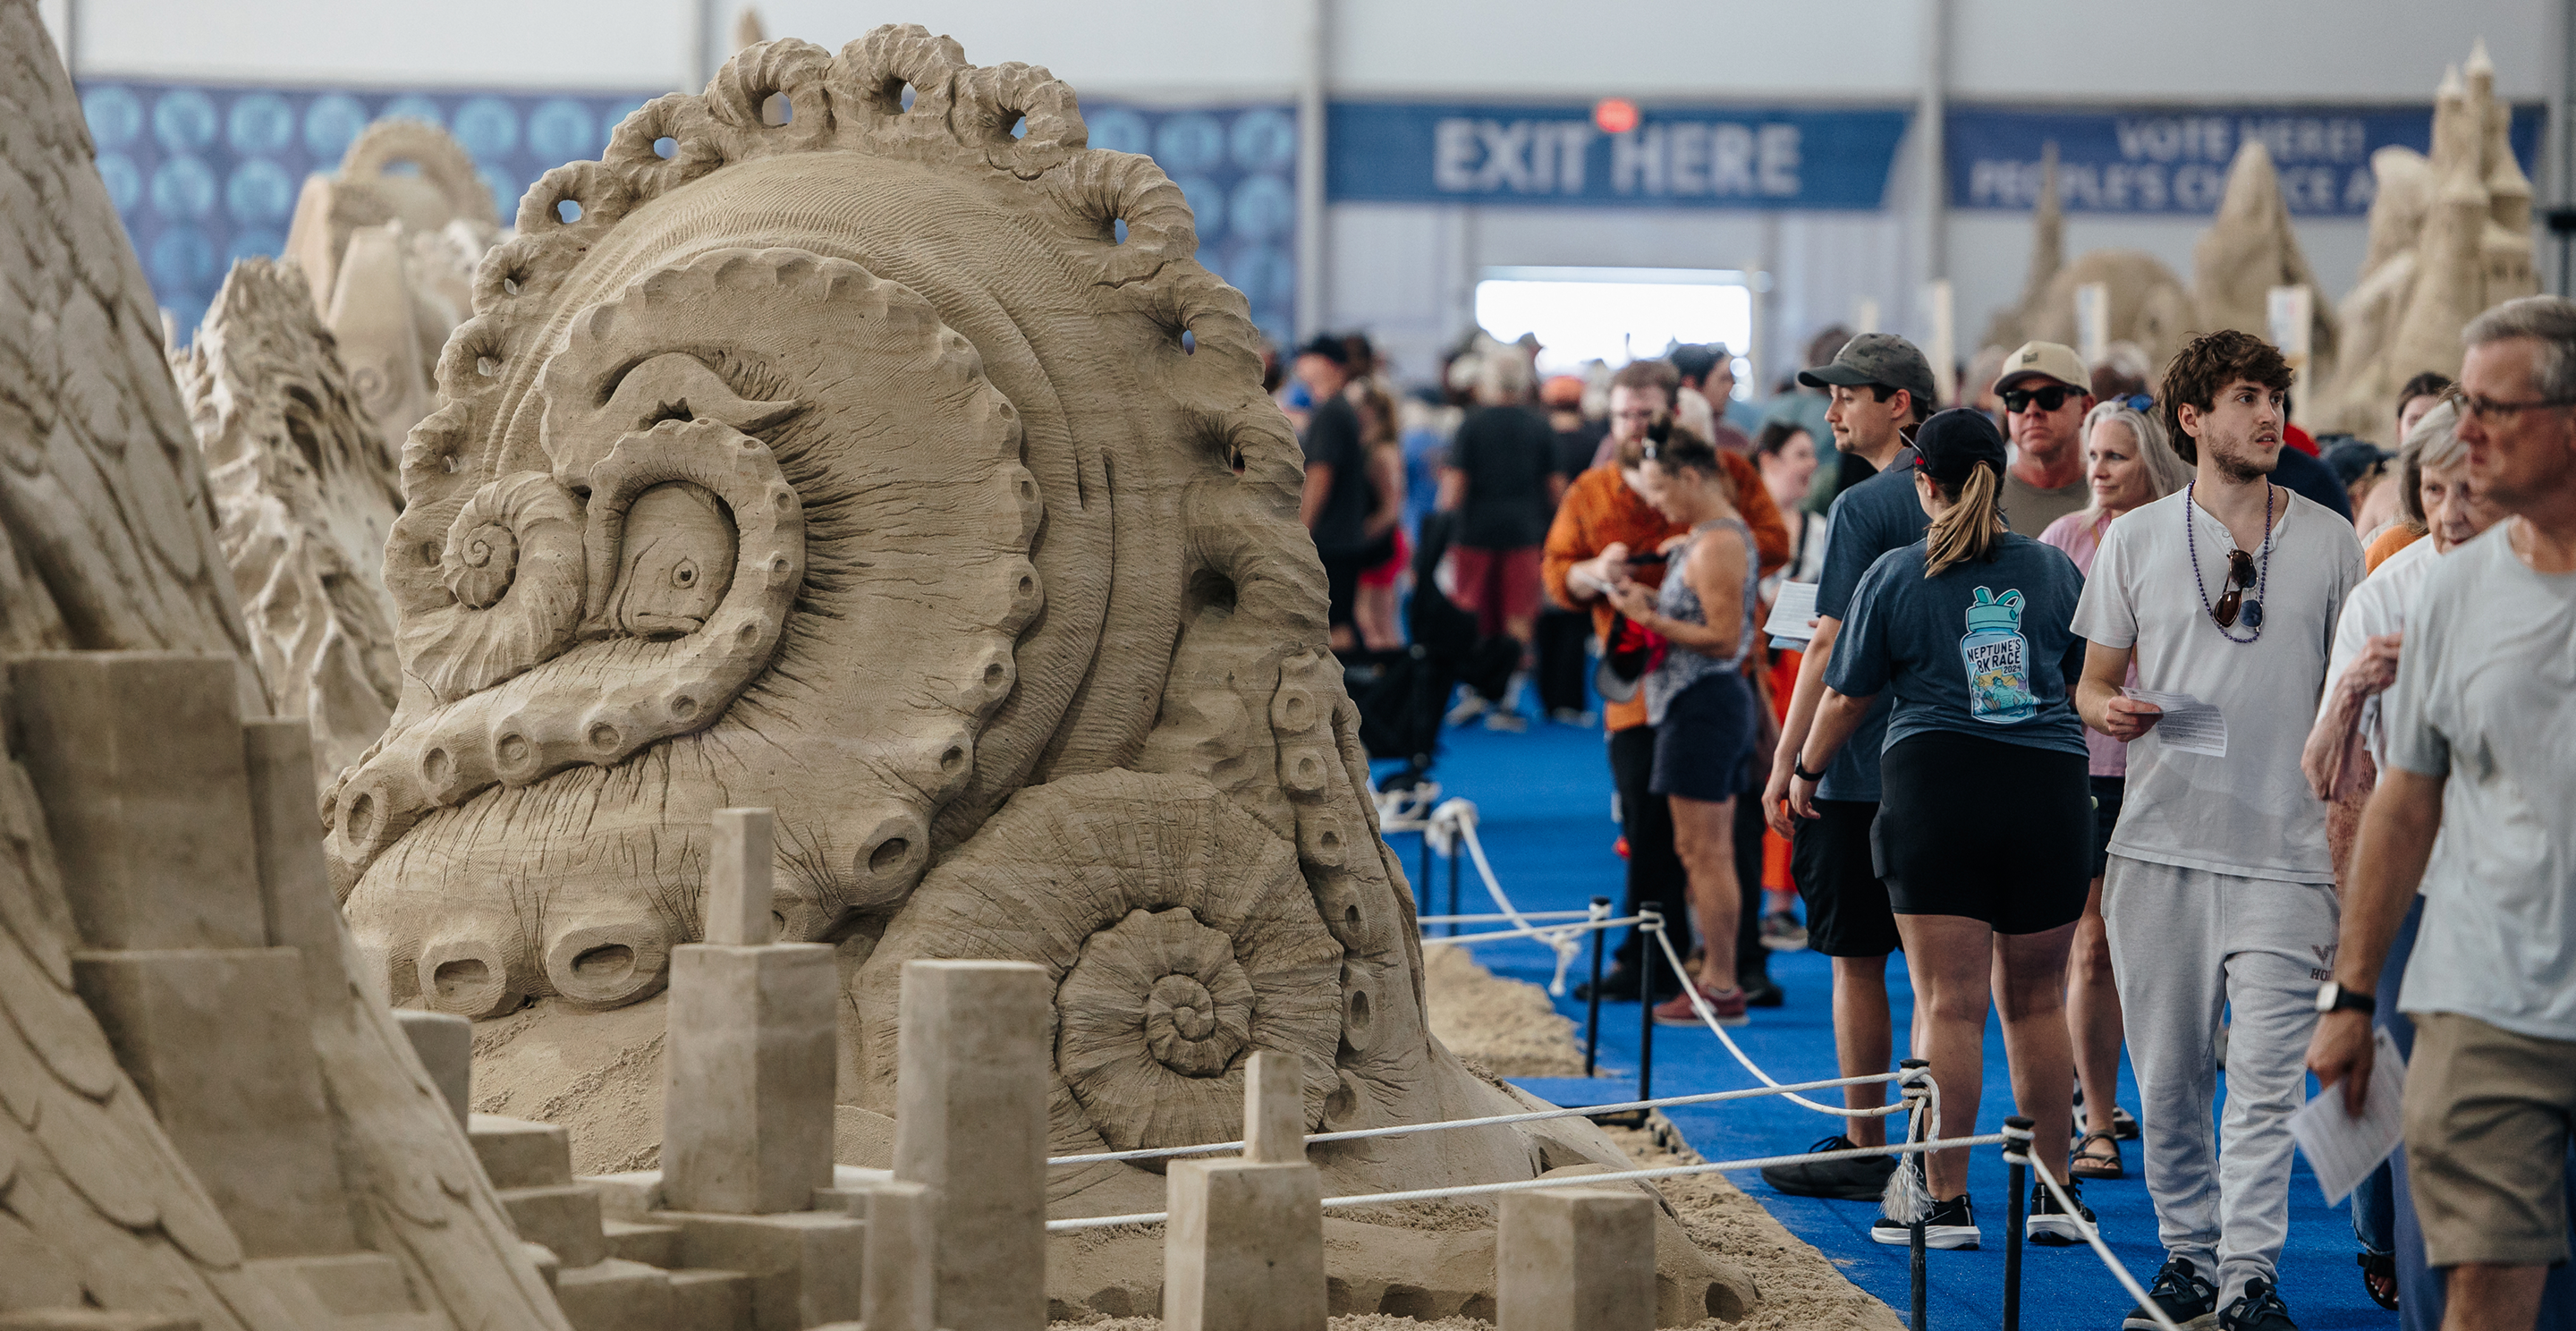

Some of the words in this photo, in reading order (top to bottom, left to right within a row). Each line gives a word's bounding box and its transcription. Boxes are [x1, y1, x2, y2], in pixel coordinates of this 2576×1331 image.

[2116, 117, 2230, 161] VOTE
[1433, 116, 1589, 194] EXIT
[1610, 120, 1803, 198] HERE
[1966, 639, 2021, 663] NEPTUNE'S
[1977, 657, 1991, 674] 8K
[1992, 650, 2021, 668] RACE
[2004, 665, 2021, 674] 2024
